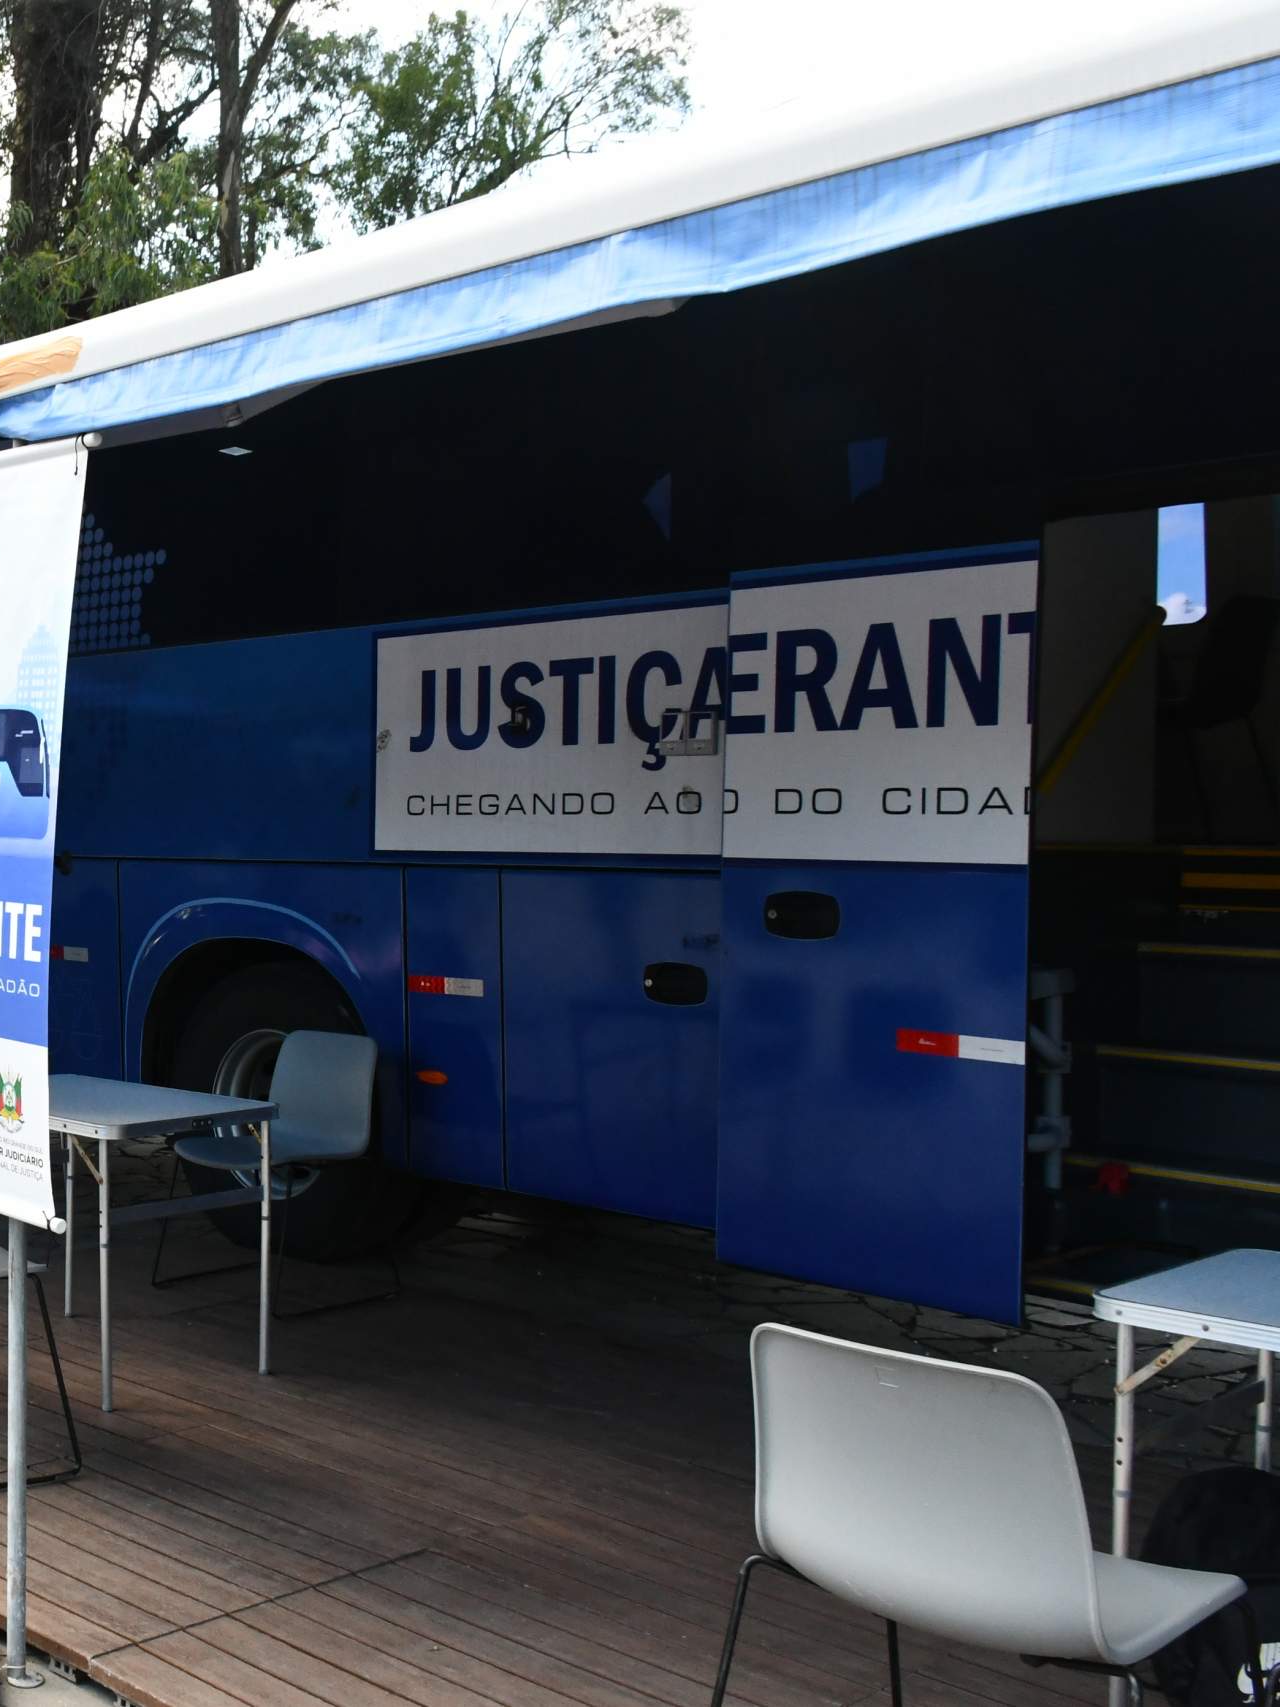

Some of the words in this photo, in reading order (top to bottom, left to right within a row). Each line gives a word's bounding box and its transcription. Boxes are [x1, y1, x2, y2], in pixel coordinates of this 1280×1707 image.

[409, 645, 727, 772] JUSTIÇA
[406, 792, 616, 816] CHEGANDO
[643, 790, 703, 815] AO
[774, 787, 843, 815] DO
[881, 786, 1031, 816] CIDA
